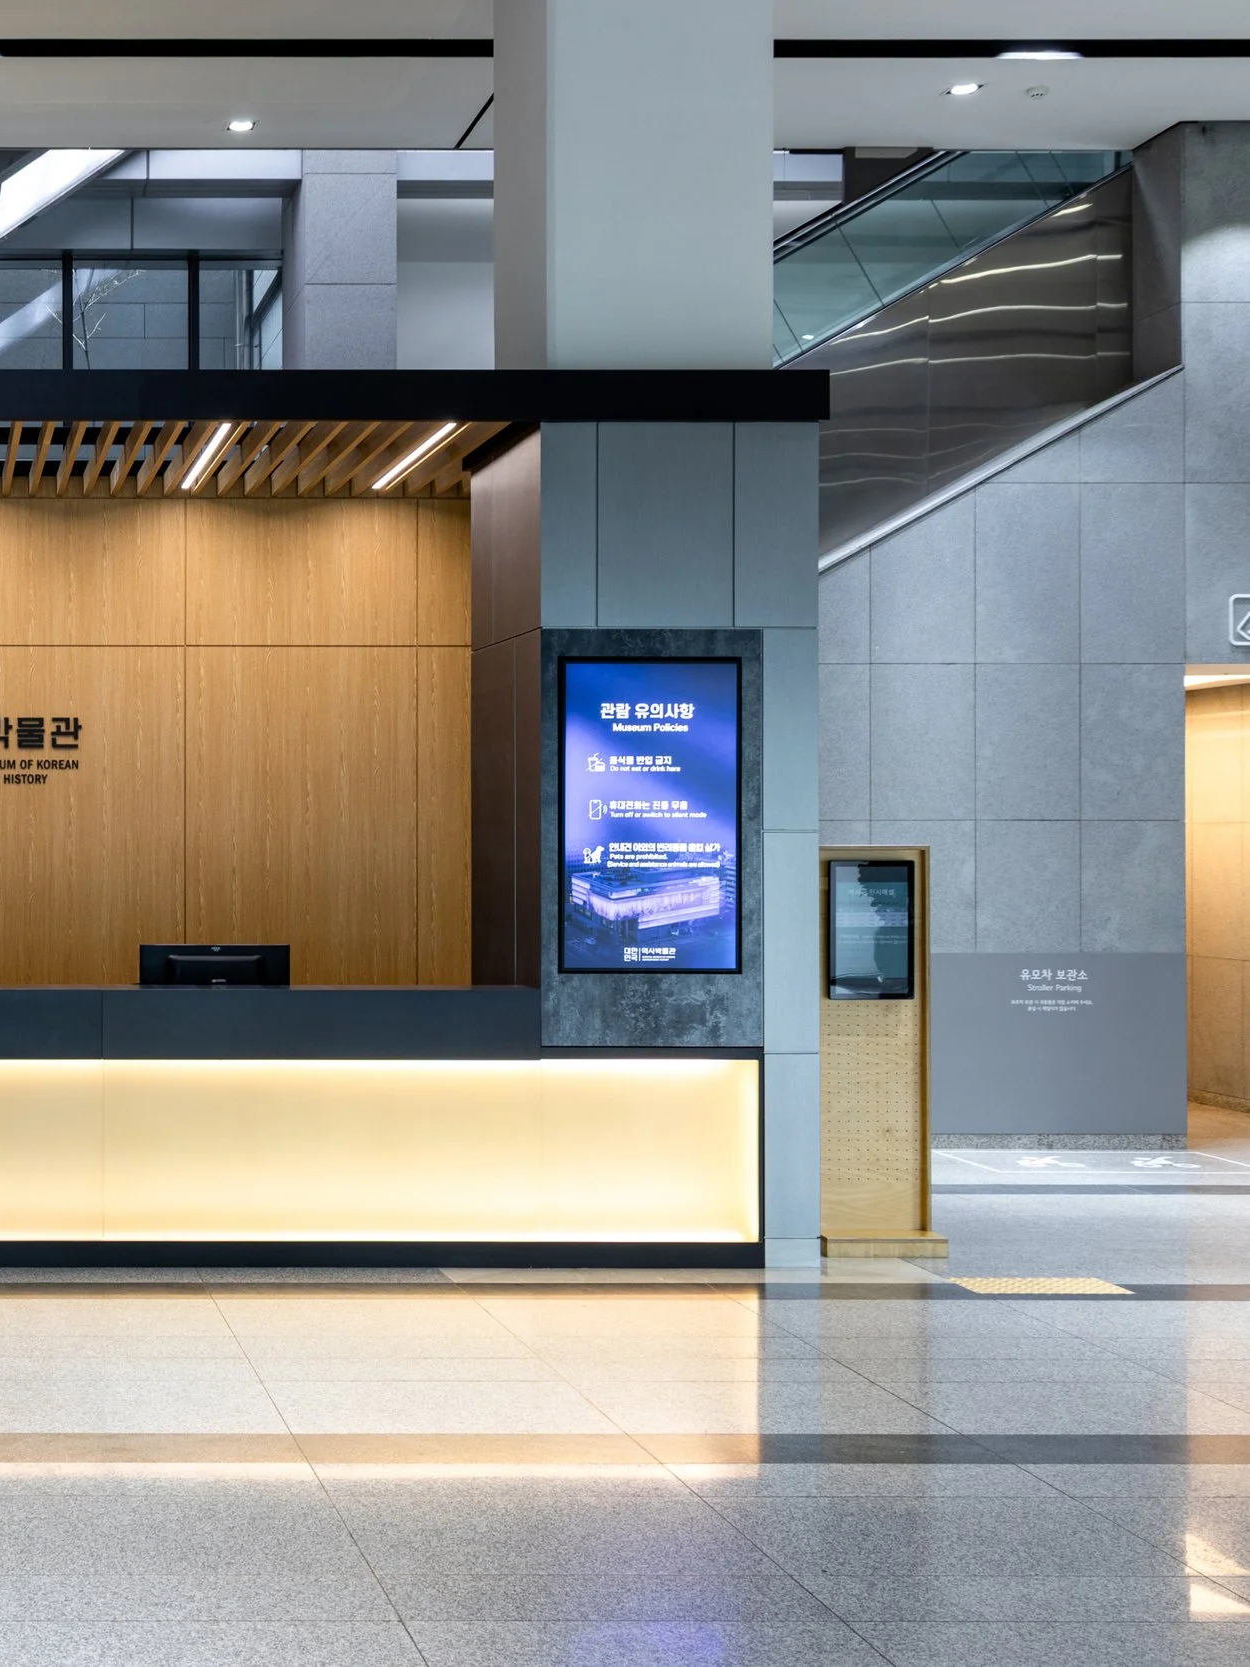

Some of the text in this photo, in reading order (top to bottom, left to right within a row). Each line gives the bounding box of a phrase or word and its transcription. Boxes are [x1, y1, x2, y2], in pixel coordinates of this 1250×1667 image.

[600, 703, 695, 719] 관람 유의사항
[612, 723, 688, 732] Museum Policies
[19, 759, 33, 770] OF
[37, 759, 79, 770] KOREAN
[655, 756, 672, 765] 금지
[3, 774, 48, 785] HISTORY
[1020, 969, 1088, 981] 유모차 보관소
[1056, 984, 1082, 992] Parking
